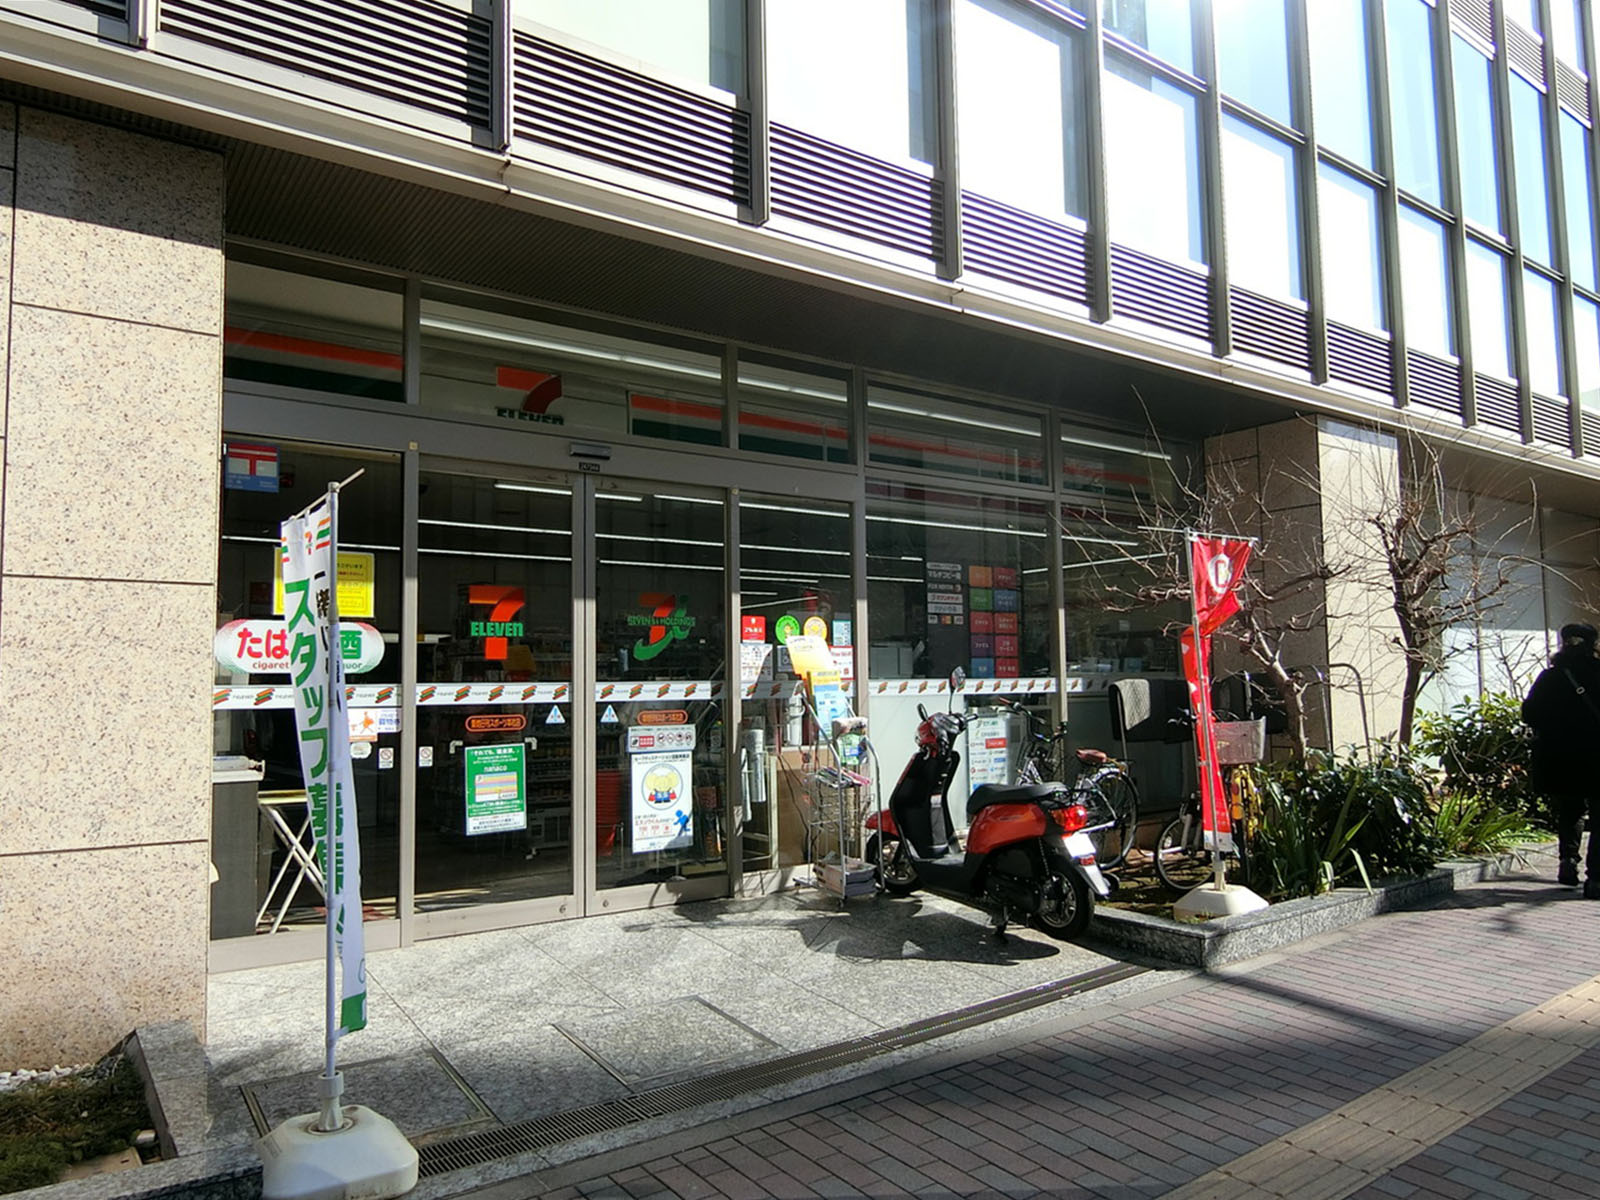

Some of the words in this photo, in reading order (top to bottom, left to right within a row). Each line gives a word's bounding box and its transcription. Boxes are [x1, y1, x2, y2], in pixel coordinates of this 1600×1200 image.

[471, 621, 524, 637] ELEVEN
[252, 661, 290, 670] cigaret
[285, 578, 346, 935] スタッフ募集
